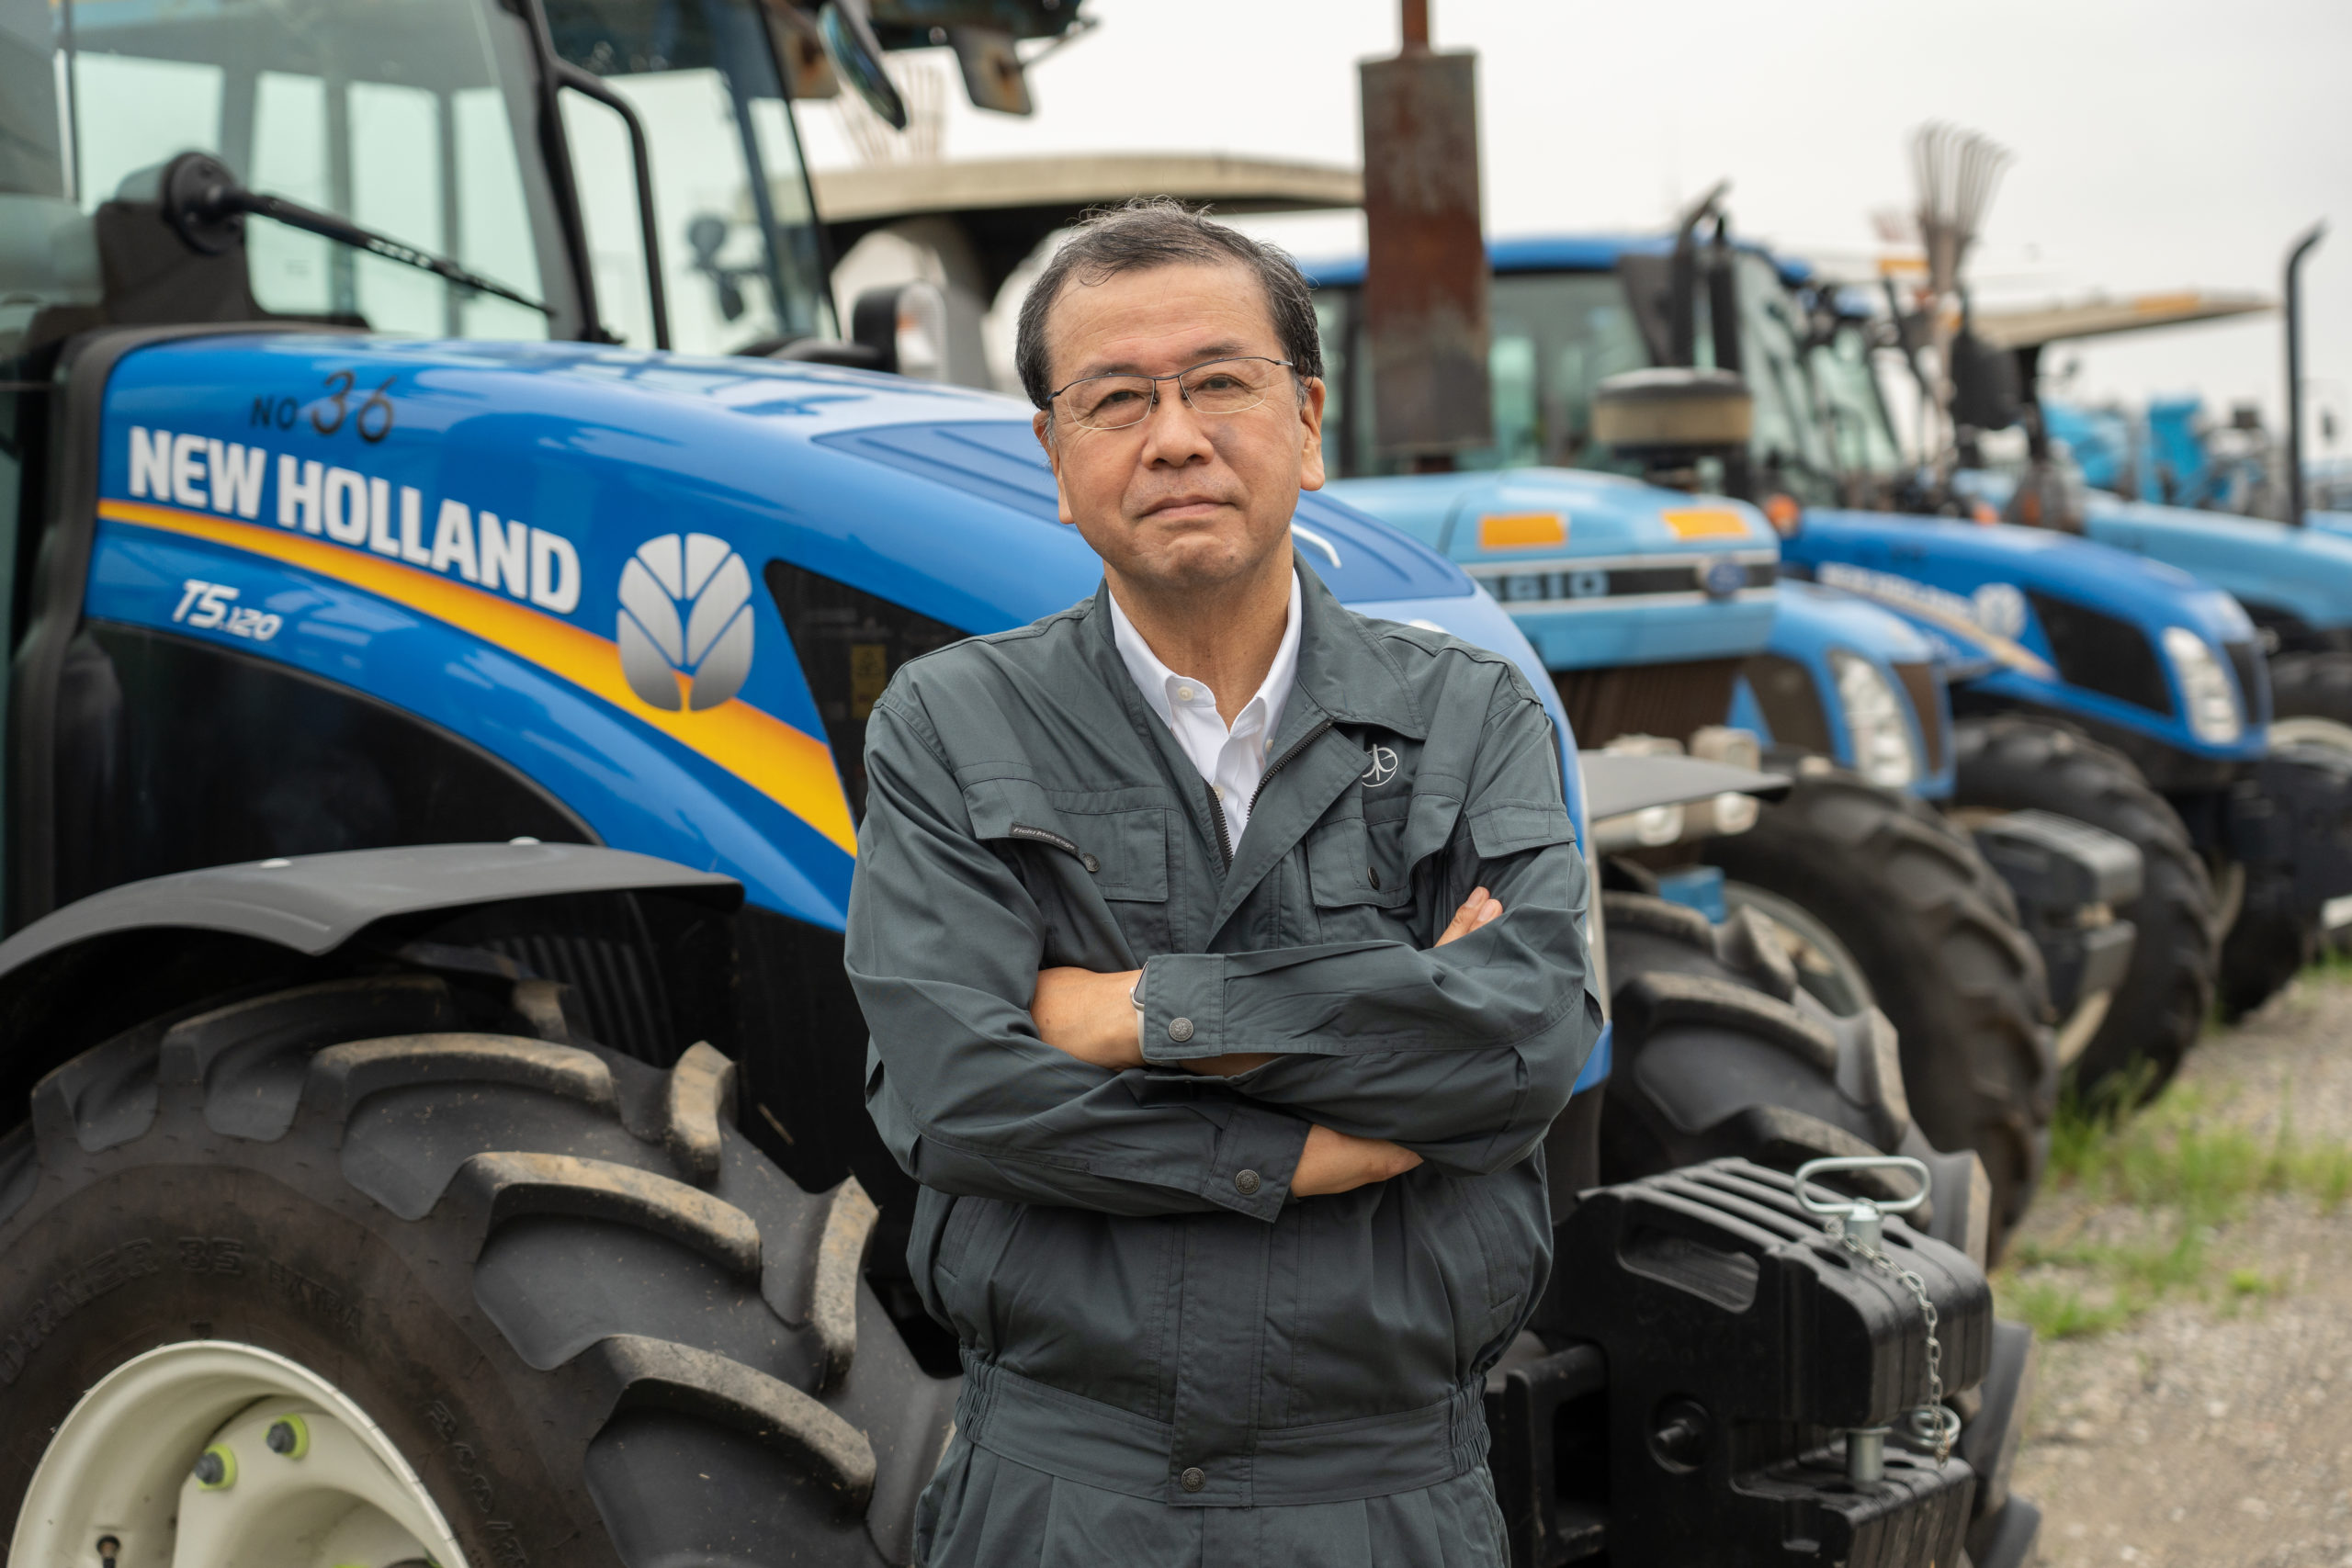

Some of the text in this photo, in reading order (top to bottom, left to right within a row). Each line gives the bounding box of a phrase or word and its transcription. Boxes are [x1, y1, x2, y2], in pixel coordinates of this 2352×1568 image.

[250, 369, 398, 444] NO 36
[129, 425, 582, 615] NEW HOLLAND
